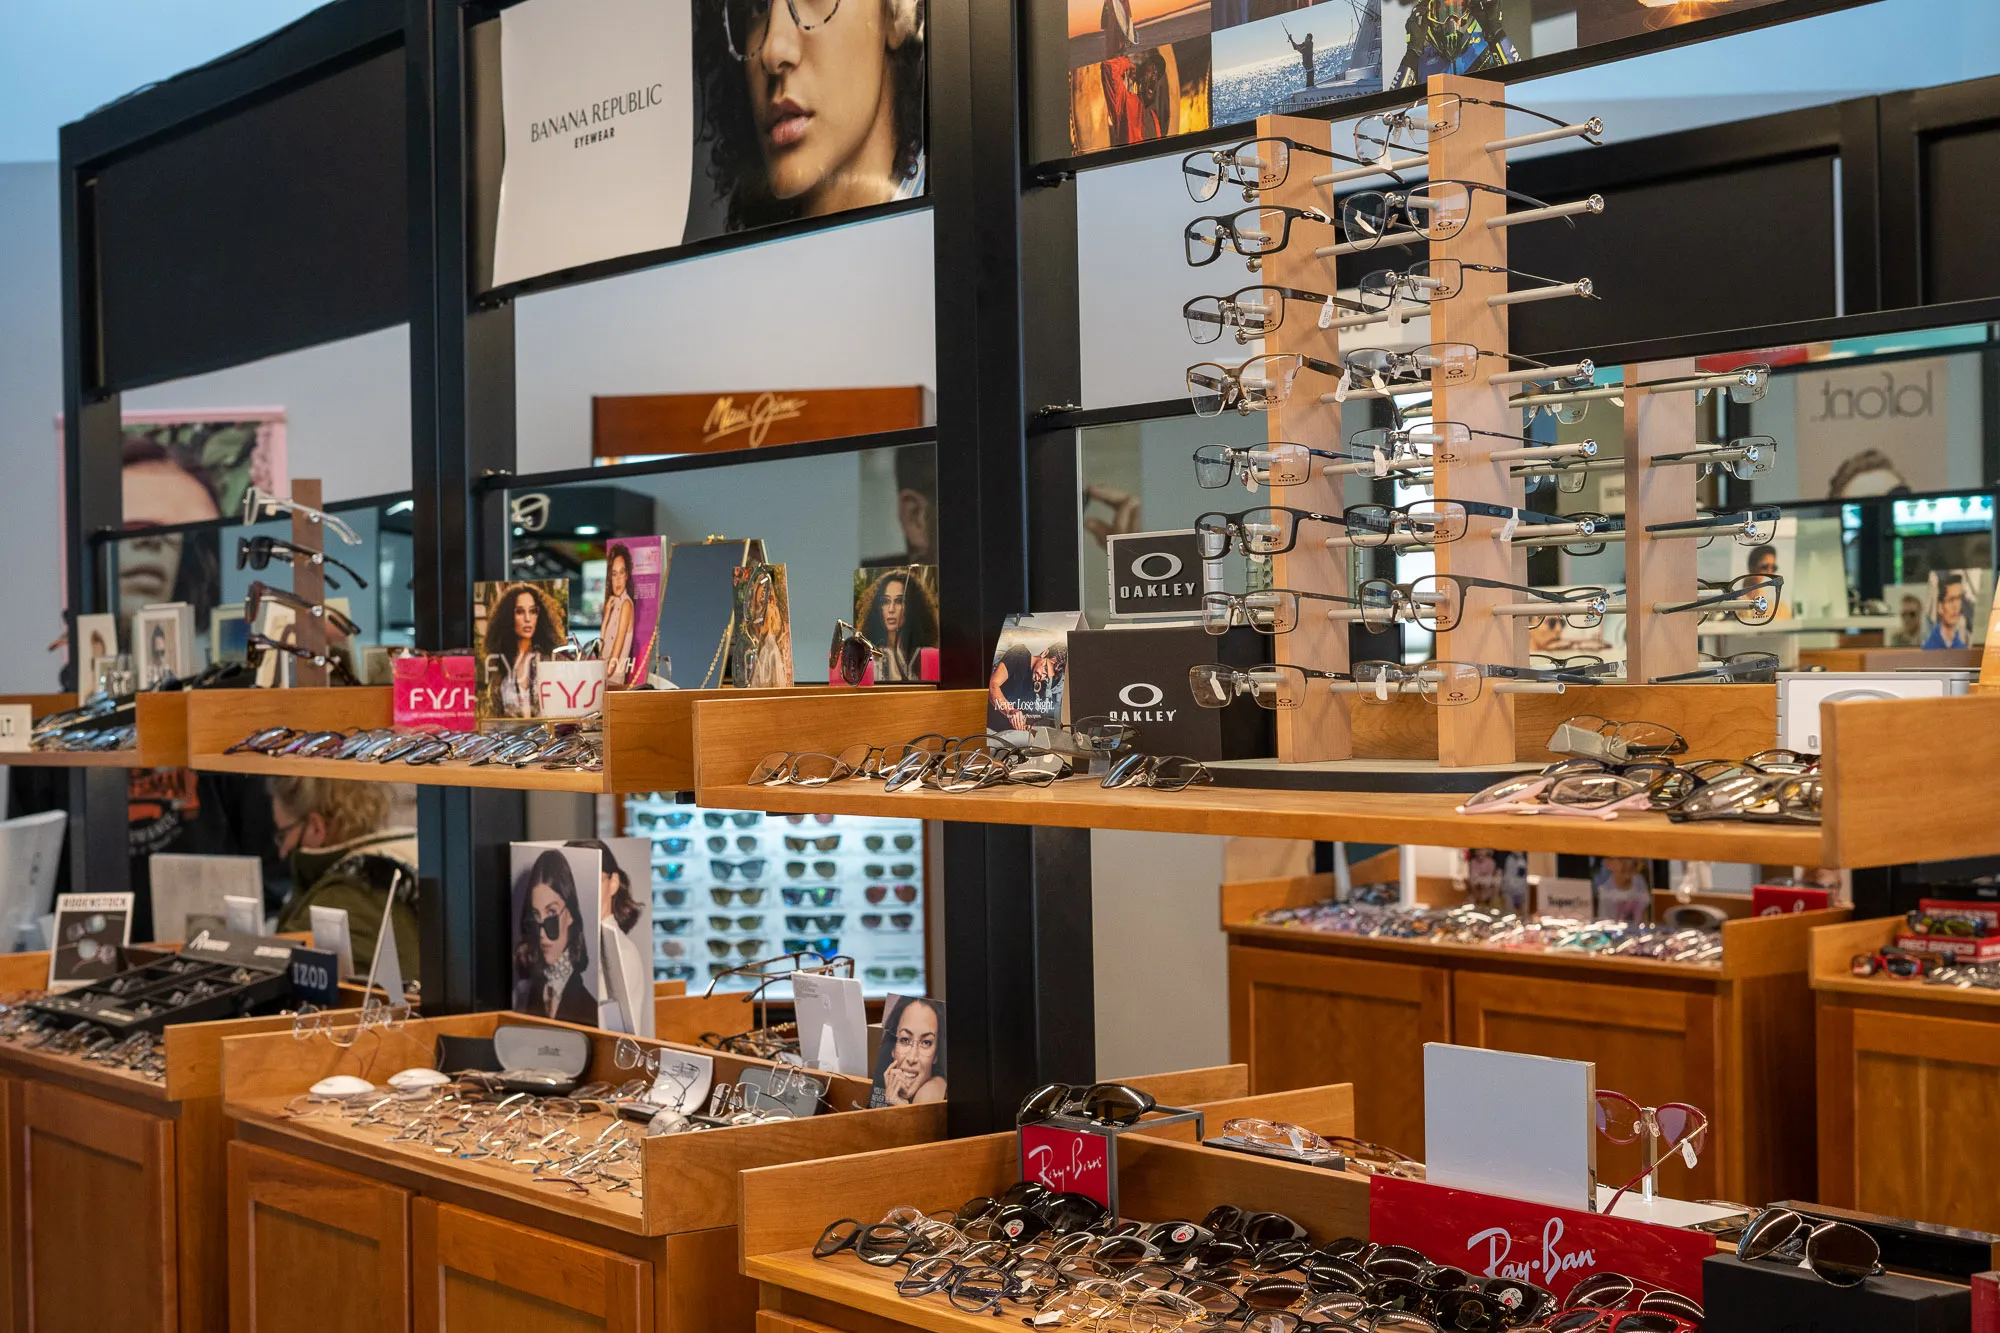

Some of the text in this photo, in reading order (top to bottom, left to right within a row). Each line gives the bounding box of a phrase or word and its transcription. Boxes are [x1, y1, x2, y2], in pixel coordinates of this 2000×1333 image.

[531, 83, 662, 143] BANANA REPUBLIC
[574, 127, 615, 148] EYEWEAR
[1120, 582, 1196, 599] OAKLEY
[539, 680, 604, 709] FYS
[994, 698, 1055, 713] Never Lose Sight.
[1109, 709, 1177, 722] OAKLEY
[293, 962, 328, 991] IZOD
